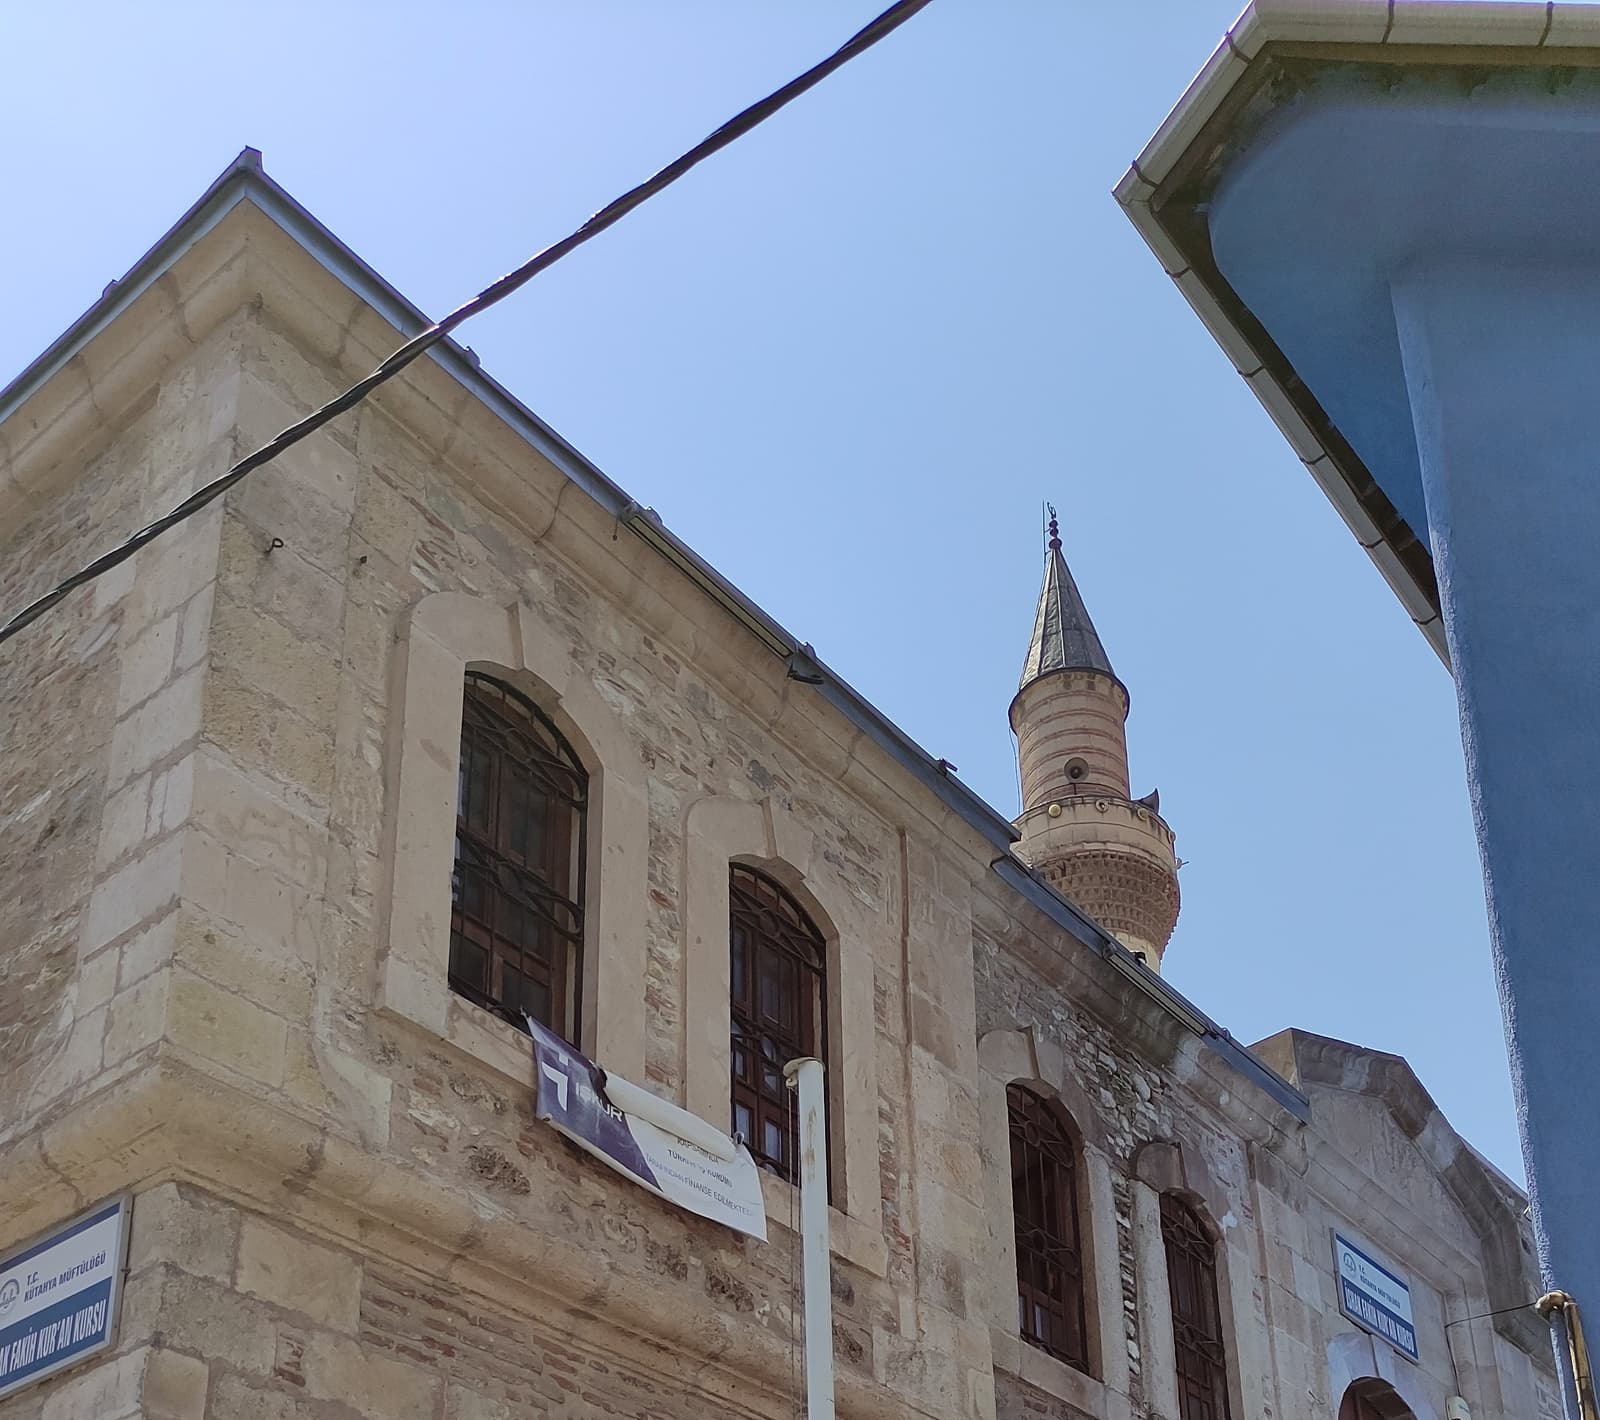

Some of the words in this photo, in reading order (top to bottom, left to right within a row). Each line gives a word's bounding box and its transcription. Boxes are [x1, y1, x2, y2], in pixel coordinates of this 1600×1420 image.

[24, 1276, 57, 1302] KÜTAHYA
[59, 1250, 106, 1286] MÜFTÜLÜĞÜ
[9, 1326, 38, 1372] FAKİH
[36, 1315, 74, 1360] KUR'AN
[72, 1298, 107, 1343] KURSU
